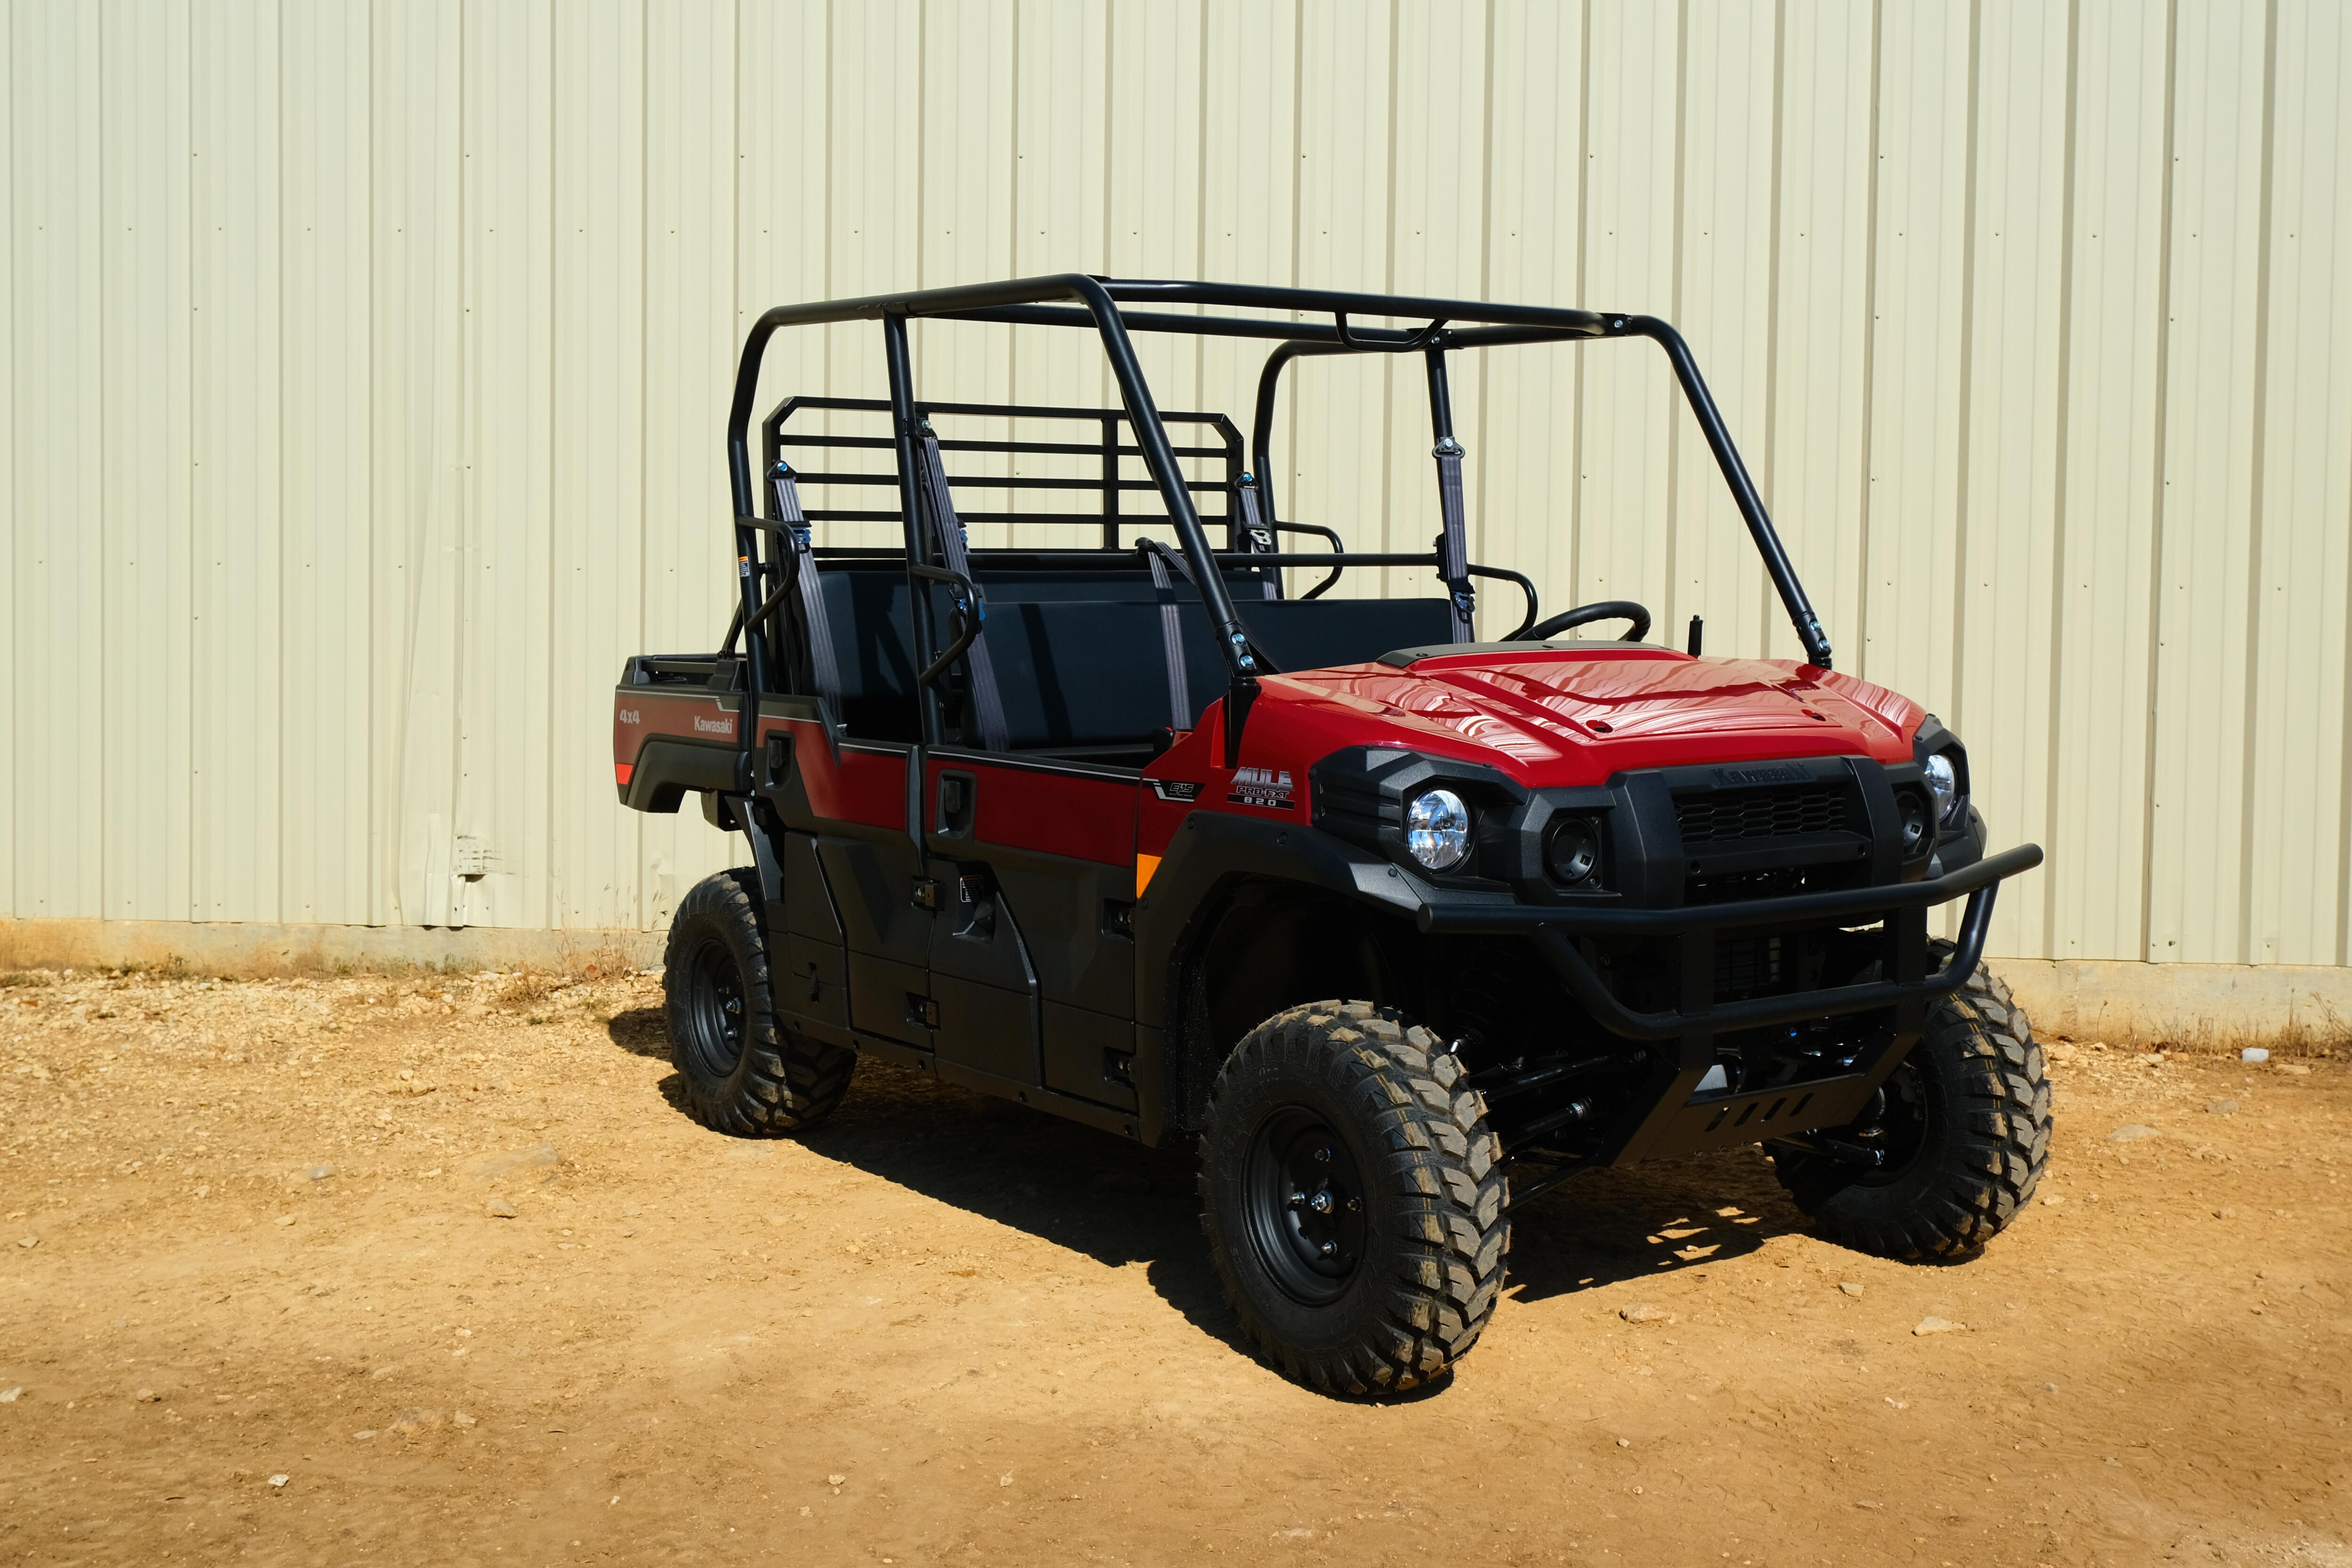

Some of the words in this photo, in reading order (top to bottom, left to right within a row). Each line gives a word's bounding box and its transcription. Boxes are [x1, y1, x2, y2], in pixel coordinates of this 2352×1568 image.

[620, 709, 640, 724] 4x4
[694, 716, 732, 734] Kawasaki
[1230, 767, 1294, 790] MULE
[1710, 763, 1812, 785] Kawasaki
[1170, 783, 1194, 793] EPS
[1236, 785, 1290, 799] PRO-FXT
[1244, 796, 1276, 807] 820
